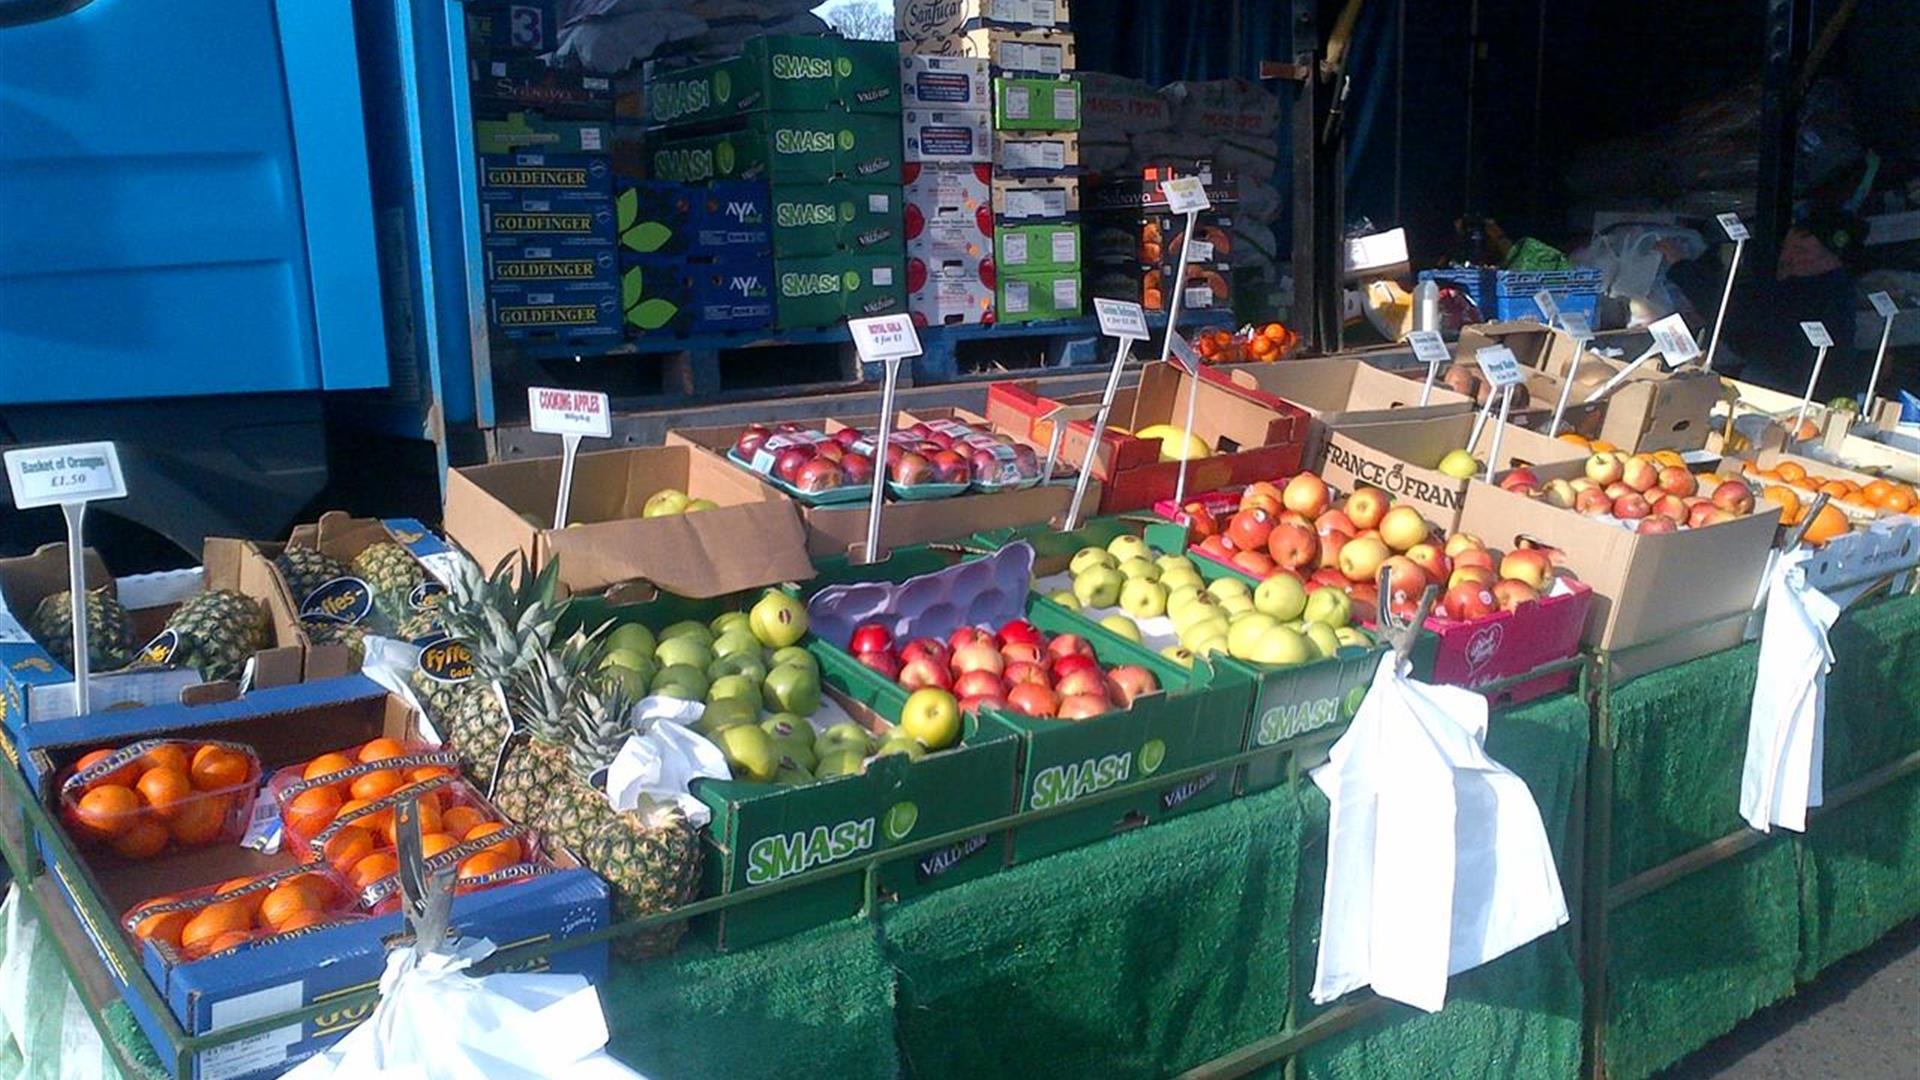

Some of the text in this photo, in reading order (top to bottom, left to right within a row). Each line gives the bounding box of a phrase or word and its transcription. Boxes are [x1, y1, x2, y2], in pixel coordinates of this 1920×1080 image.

[513, 9, 541, 46] 3
[773, 54, 832, 79] SMASH
[653, 79, 710, 121] SMASH
[776, 129, 835, 154] SMASH
[489, 170, 586, 185] GOLDFINGER
[655, 149, 713, 182] SMASH
[495, 216, 591, 231] GOLDFINGER
[726, 202, 757, 223] AYA
[777, 203, 836, 227] SMASH
[497, 263, 593, 277] GOLDFINGER
[730, 277, 761, 297] AYA
[781, 273, 840, 297] SMASH
[501, 308, 596, 323] GOLDFINGER
[540, 391, 599, 414] COOKING APPLES
[22, 456, 105, 474] Basket of Oranges
[1326, 442, 1465, 510] FRANCE FRAN
[52, 474, 86, 487] £1.50
[450, 665, 473, 678] Gold
[1259, 696, 1339, 745] SMASH
[1031, 752, 1131, 809] SMASH
[747, 818, 875, 884] SMASH
